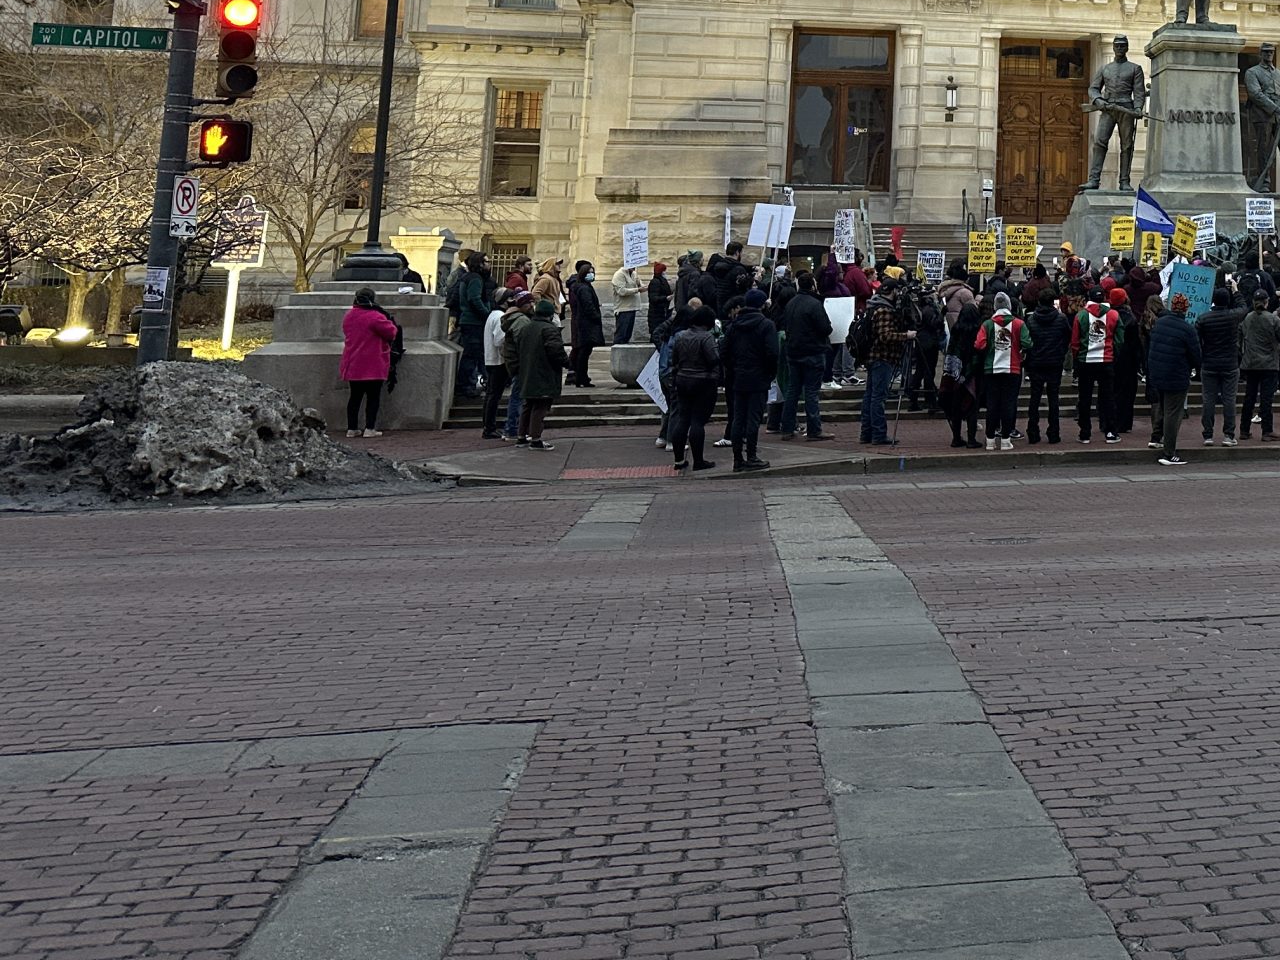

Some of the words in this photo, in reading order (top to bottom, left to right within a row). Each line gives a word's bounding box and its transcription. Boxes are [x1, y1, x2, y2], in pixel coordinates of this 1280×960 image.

[42, 34, 51, 44] W
[72, 28, 140, 47] CAPITOL
[150, 35, 163, 45] AV
[1169, 109, 1236, 125] MORTON
[920, 257, 943, 265] UNITED
[1178, 271, 1190, 280] NO
[1193, 275, 1210, 285] ONE
[1186, 285, 1197, 294] IS
[1189, 294, 1210, 305] EGAL
